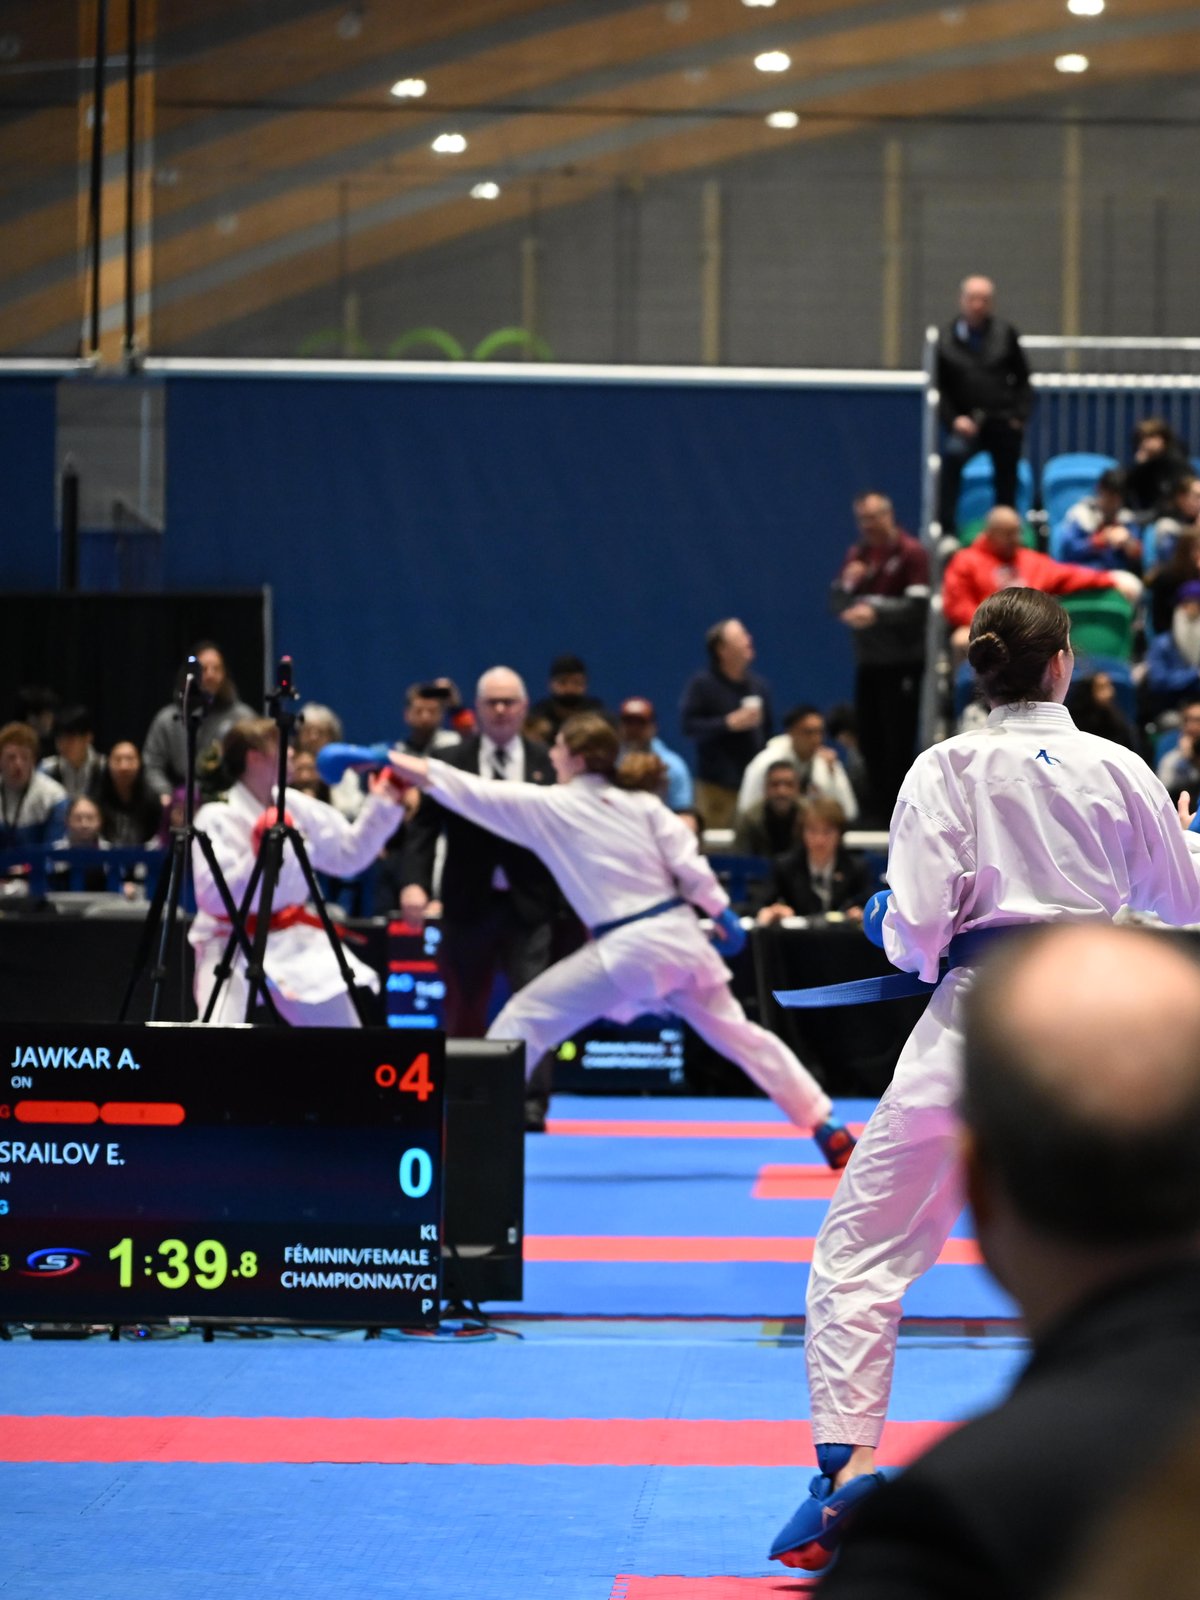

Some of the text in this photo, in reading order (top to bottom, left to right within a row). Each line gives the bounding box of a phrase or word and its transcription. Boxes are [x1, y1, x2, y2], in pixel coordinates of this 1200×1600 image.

[10, 1046, 141, 1070] JAWKAR A.
[11, 1075, 33, 1089] ON
[106, 1143, 126, 1165] E.
[399, 1147, 433, 1198] 0
[284, 1243, 430, 1266] FÉMININ/FEMALE
